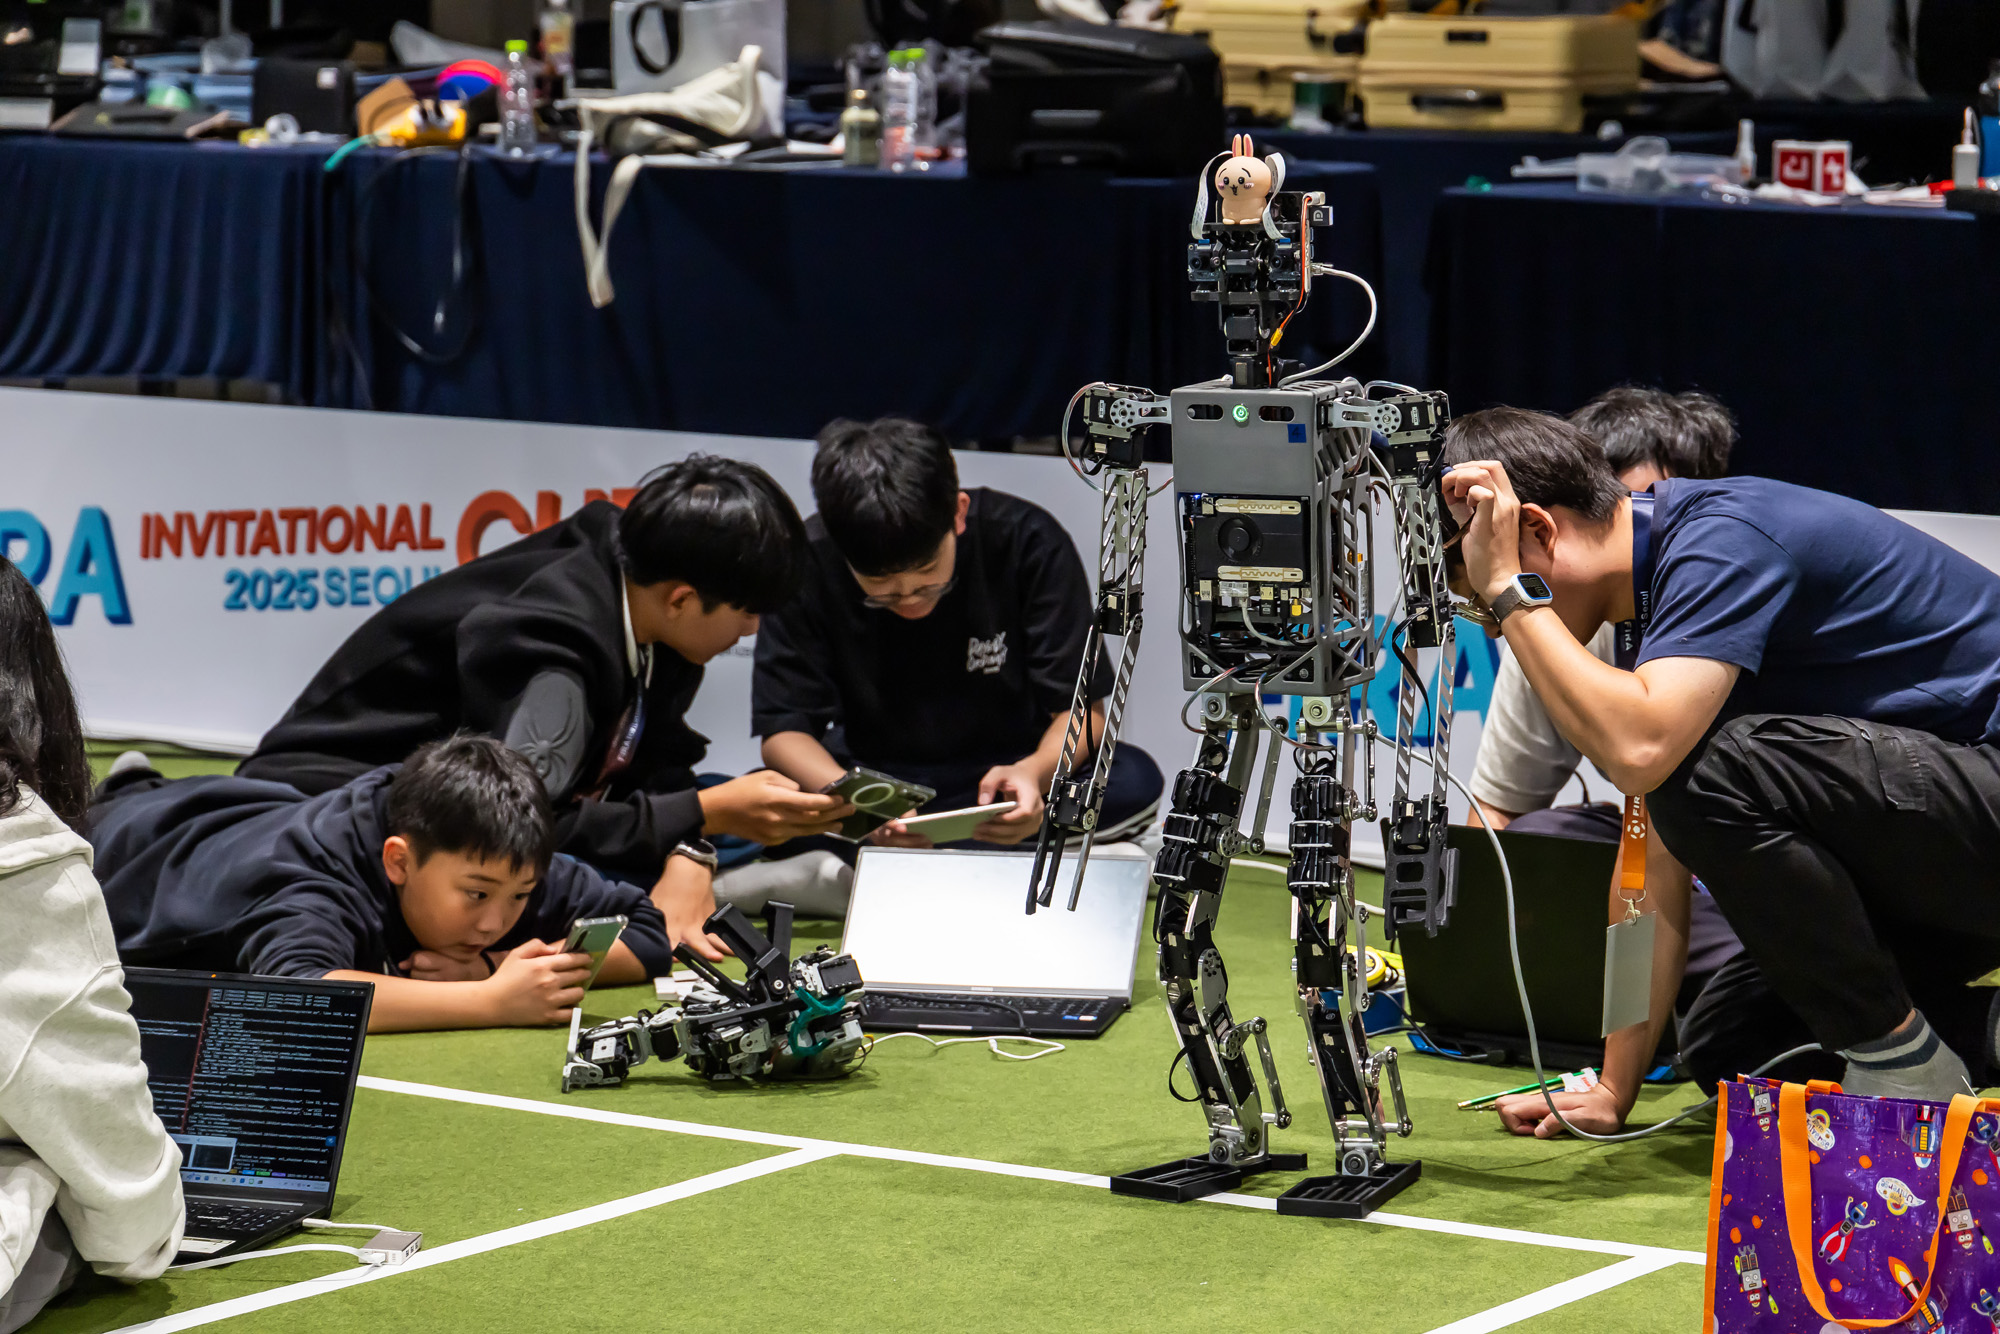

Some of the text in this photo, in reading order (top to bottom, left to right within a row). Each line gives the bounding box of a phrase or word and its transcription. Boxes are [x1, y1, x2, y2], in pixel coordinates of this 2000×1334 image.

[1291, 425, 1303, 439] 4
[140, 503, 445, 559] INVITATIONAL
[223, 567, 319, 611] 2025
[1632, 794, 1641, 817] FIR
[1807, 1119, 1830, 1149] niverse
[1881, 1179, 1914, 1203] Universe
